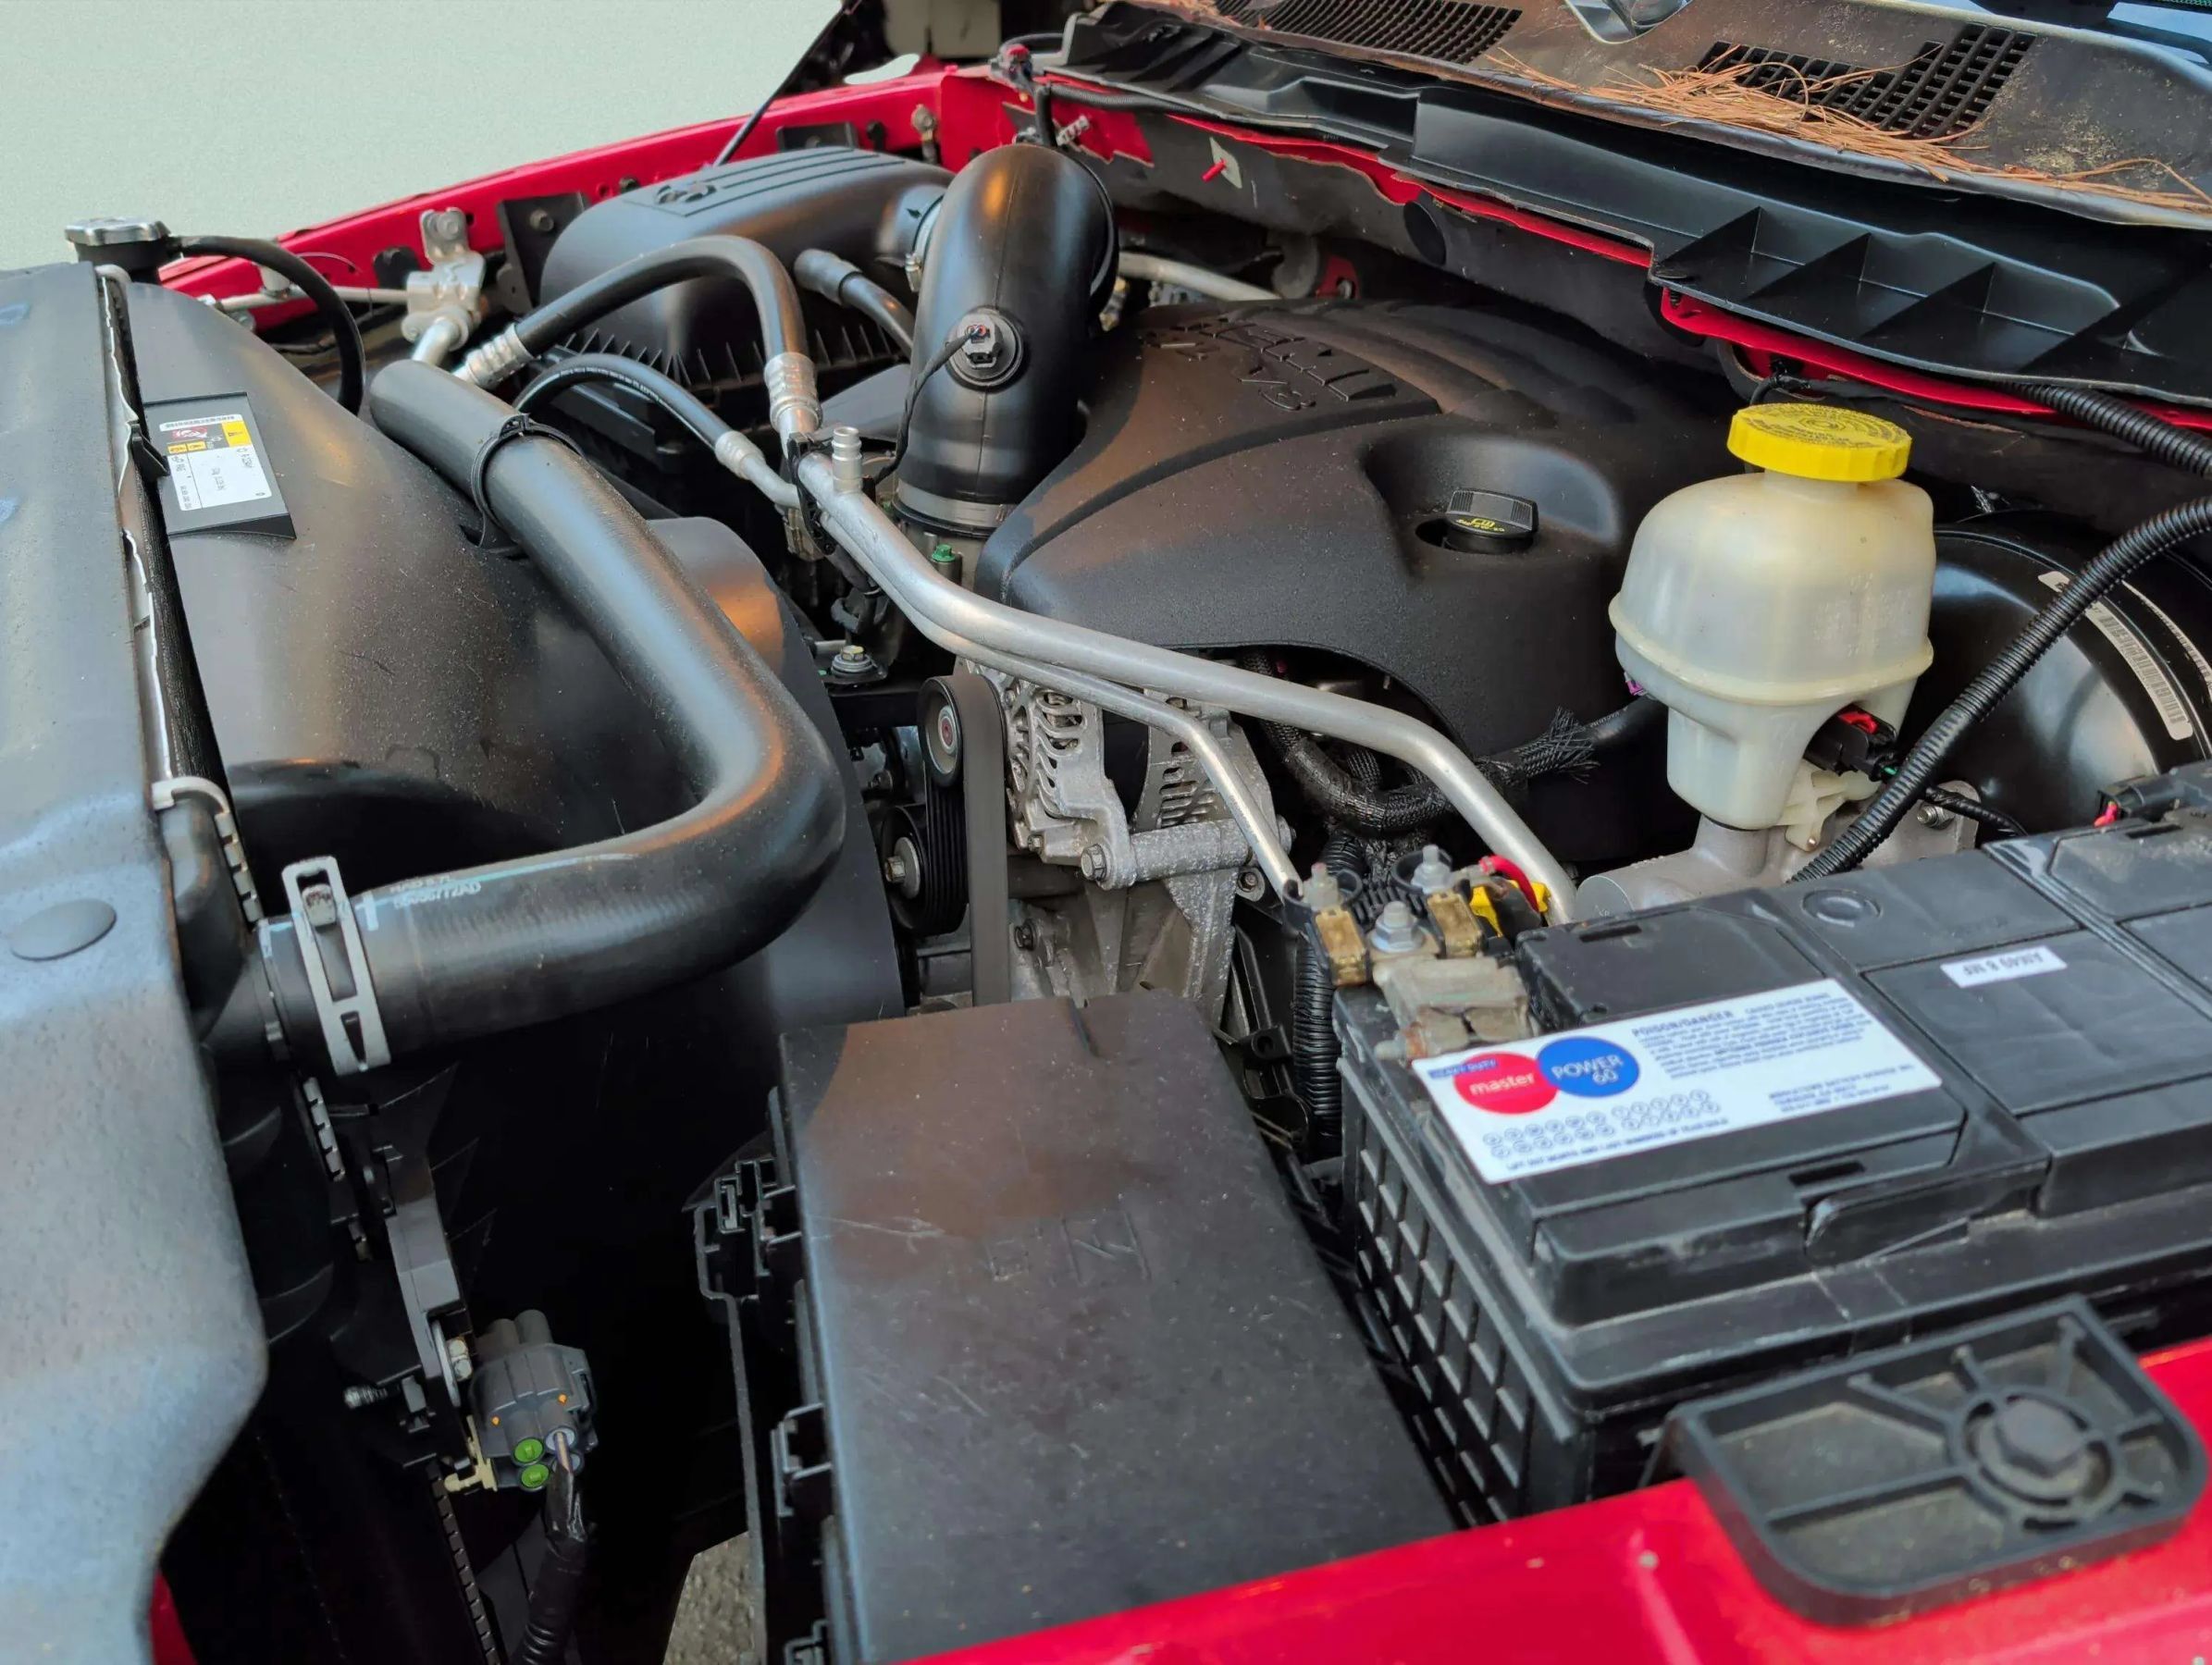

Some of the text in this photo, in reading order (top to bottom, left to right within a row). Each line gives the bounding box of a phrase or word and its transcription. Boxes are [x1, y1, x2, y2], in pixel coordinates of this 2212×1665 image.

[1551, 1054, 1625, 1079] POWER
[1591, 1069, 1620, 1086] 60
[1469, 1072, 1536, 1095] master
